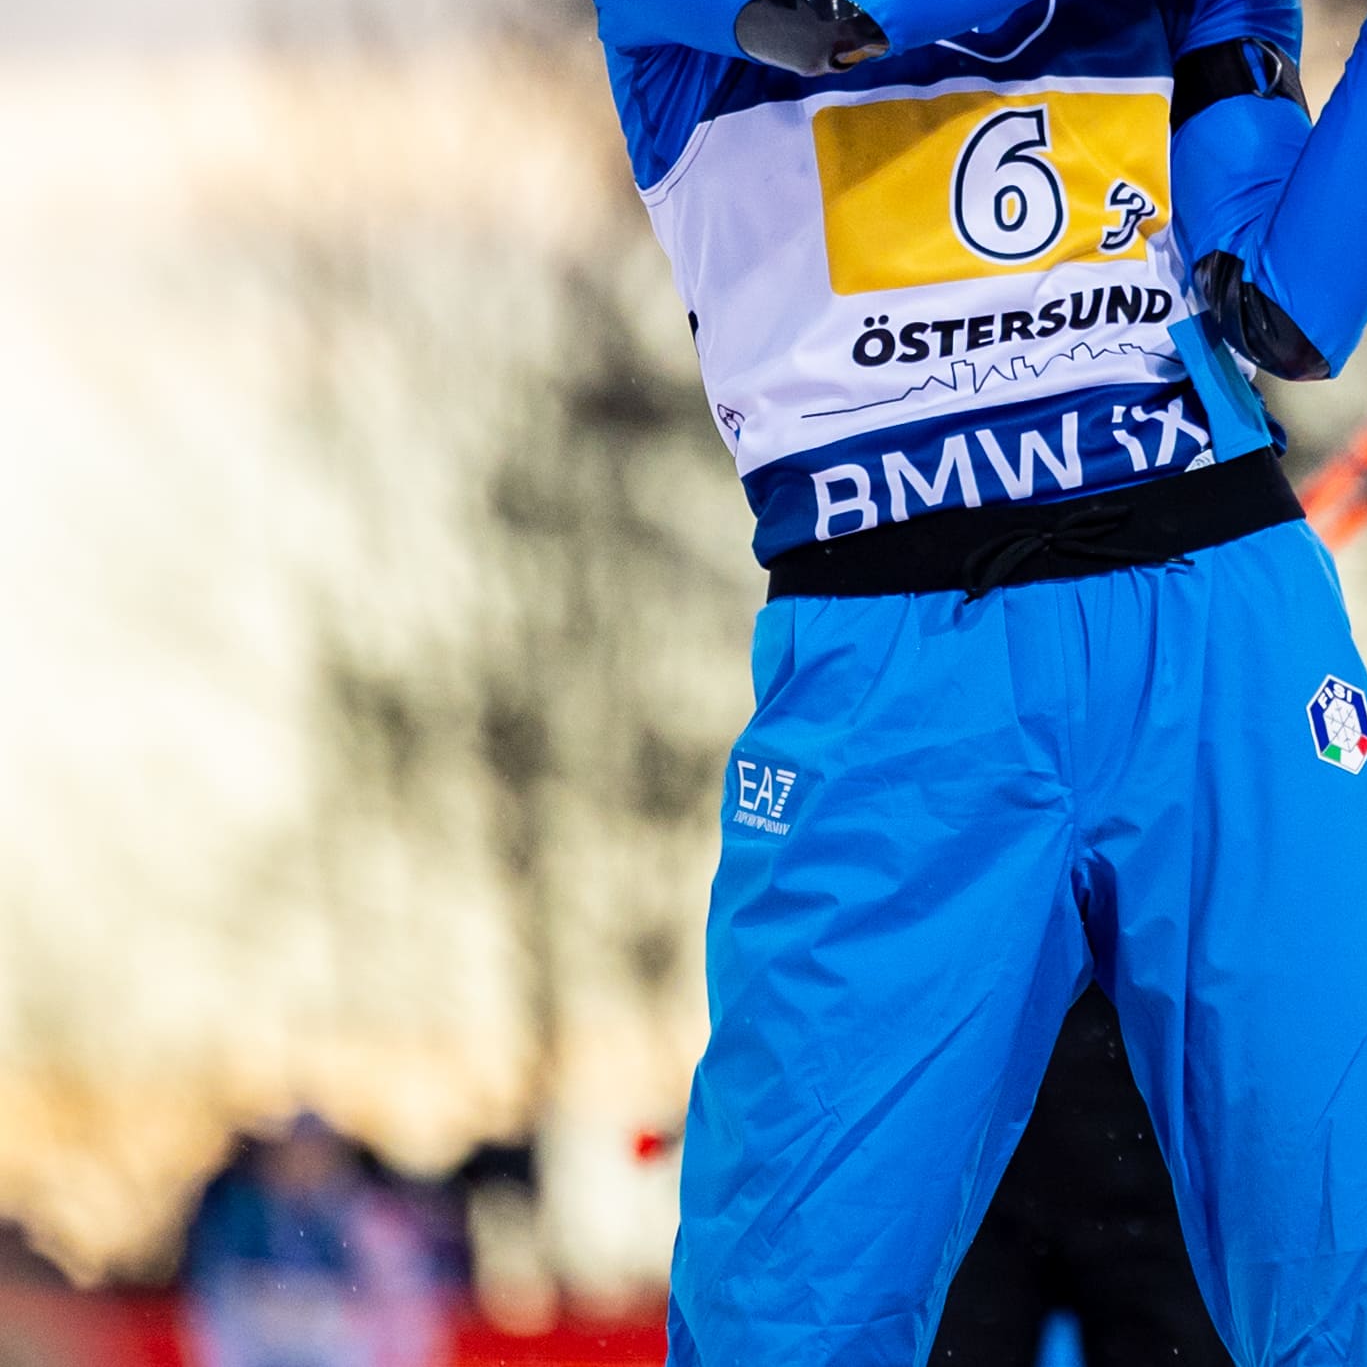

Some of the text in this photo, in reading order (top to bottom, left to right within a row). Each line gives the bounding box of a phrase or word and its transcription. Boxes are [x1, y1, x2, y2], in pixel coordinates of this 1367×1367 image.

[953, 108, 1064, 261] 6
[851, 283, 1173, 368] ÖSTERSUND
[810, 394, 1211, 541] BMW iX
[1317, 683, 1353, 710] FISI
[737, 760, 797, 819] EA7
